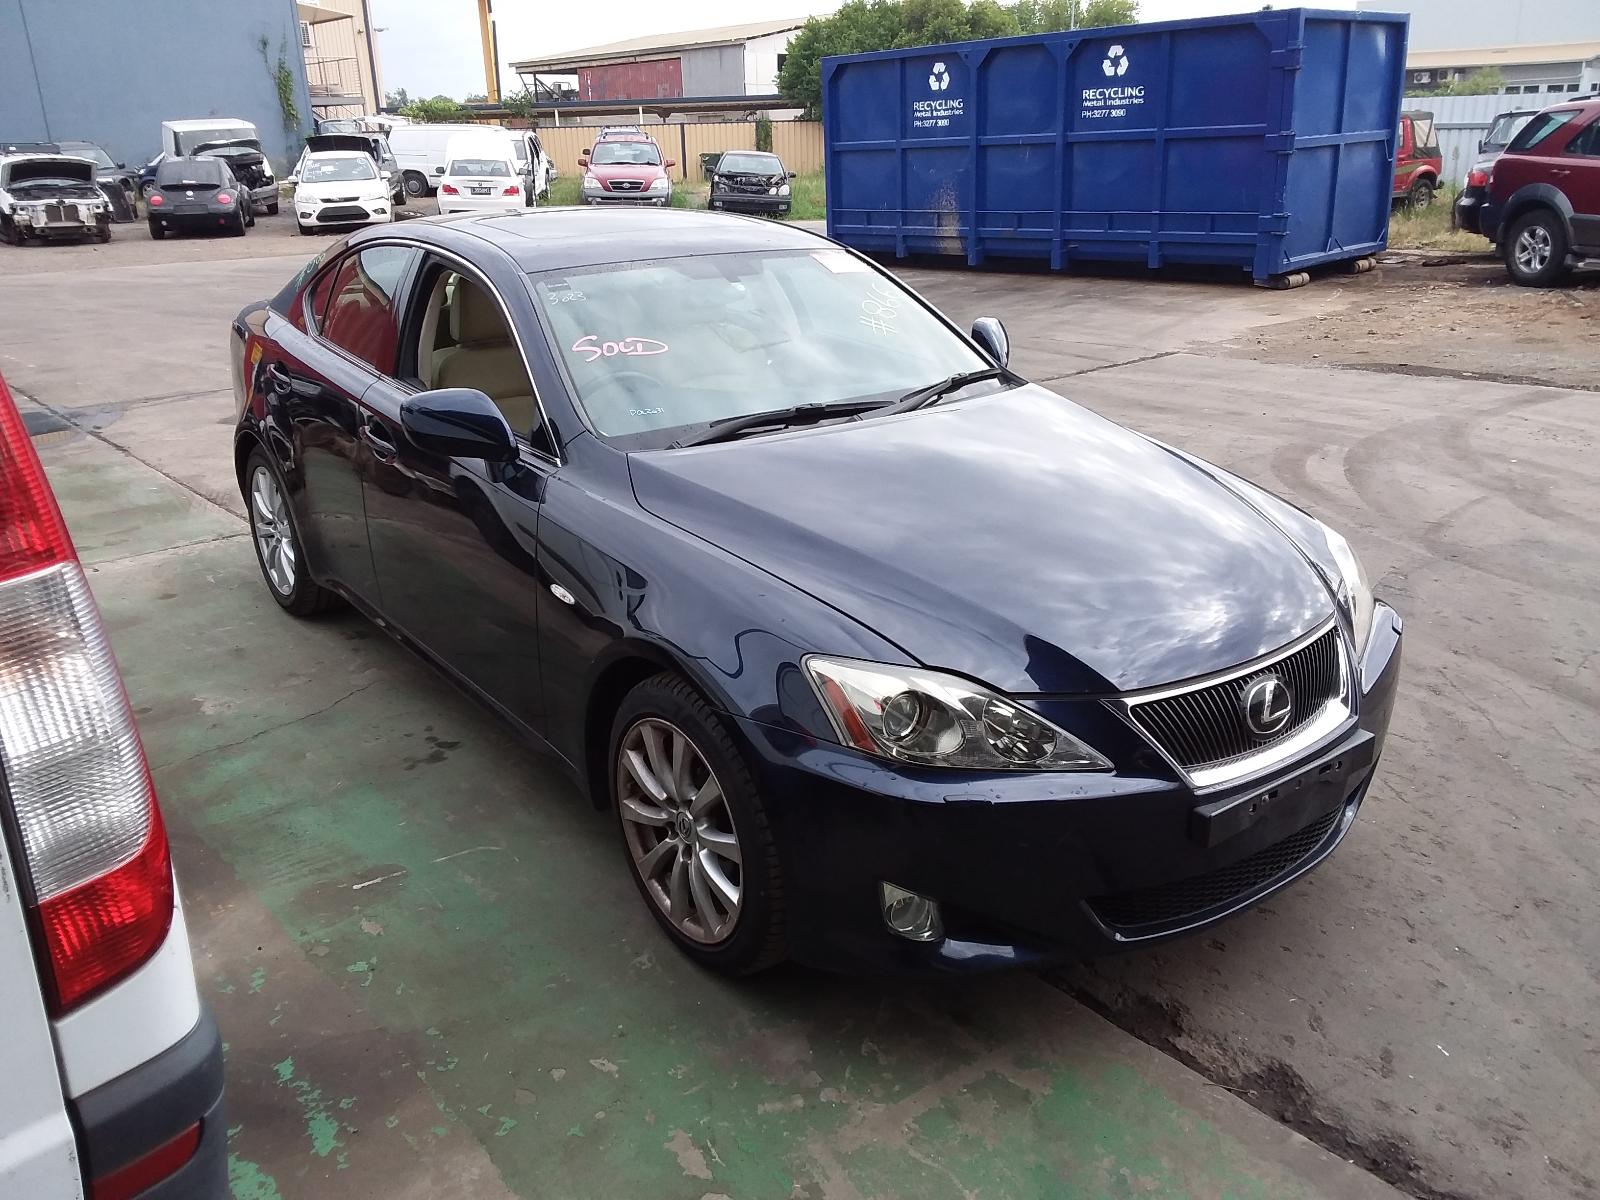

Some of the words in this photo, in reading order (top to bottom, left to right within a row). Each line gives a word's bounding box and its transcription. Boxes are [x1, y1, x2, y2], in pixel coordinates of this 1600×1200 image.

[1082, 86, 1145, 100] RECYCLING
[913, 98, 964, 111] RECYCLING
[1082, 99, 1104, 107] Metal
[1106, 98, 1144, 106] Industries
[913, 110, 932, 118] Metal
[932, 108, 964, 117] Industries
[571, 335, 669, 362] SOLD
